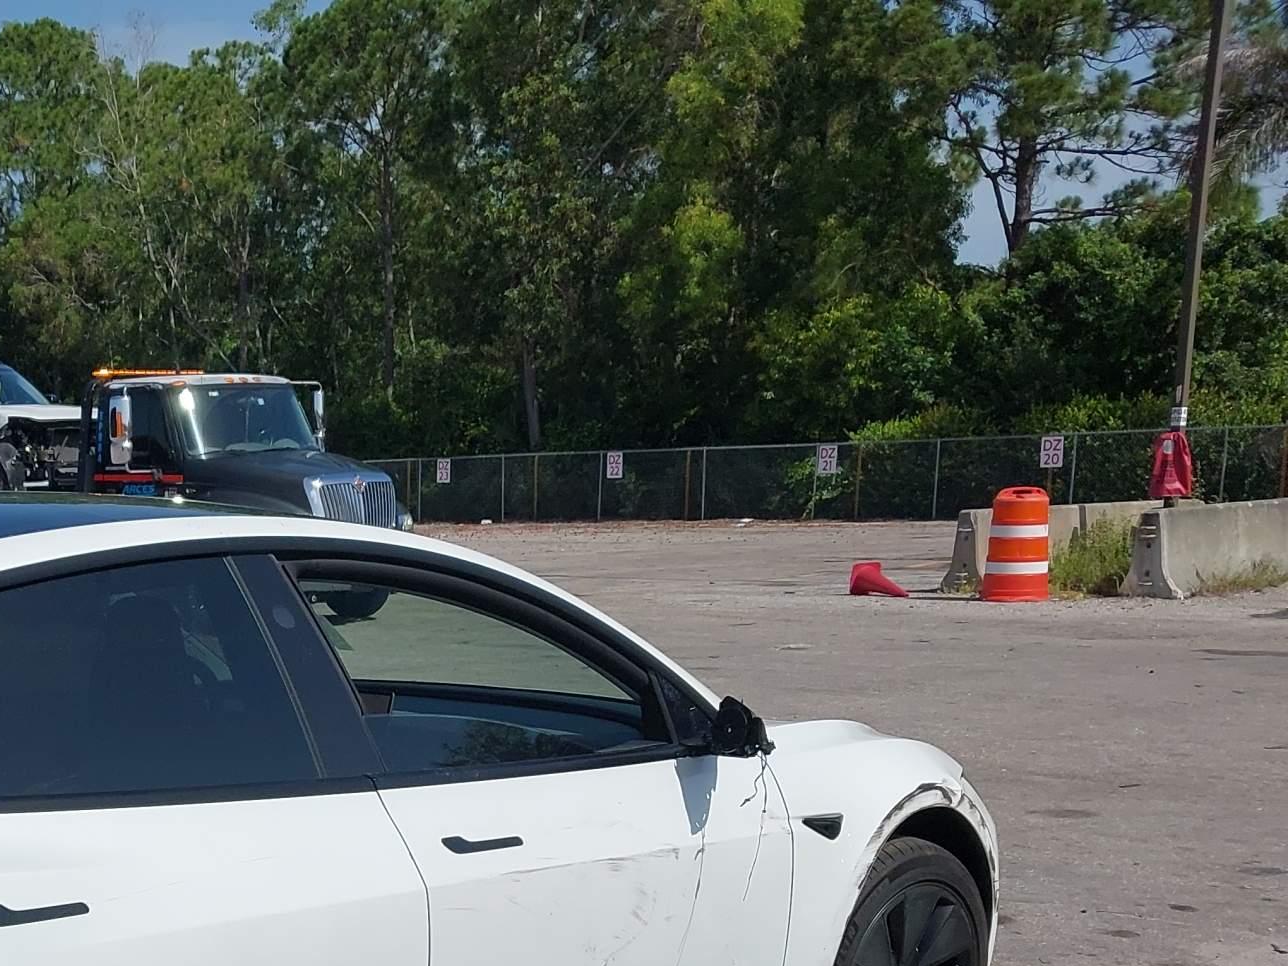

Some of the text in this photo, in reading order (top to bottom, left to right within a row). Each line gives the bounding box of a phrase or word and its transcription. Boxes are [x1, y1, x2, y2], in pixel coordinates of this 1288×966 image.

[1043, 439, 1062, 451] DZ
[821, 447, 836, 459] DZ
[608, 454, 622, 465] DZ
[1044, 453, 1059, 465] 20
[438, 460, 449, 471] DZ
[610, 465, 620, 476] 22
[822, 460, 832, 471] 21
[439, 471, 448, 481] 23
